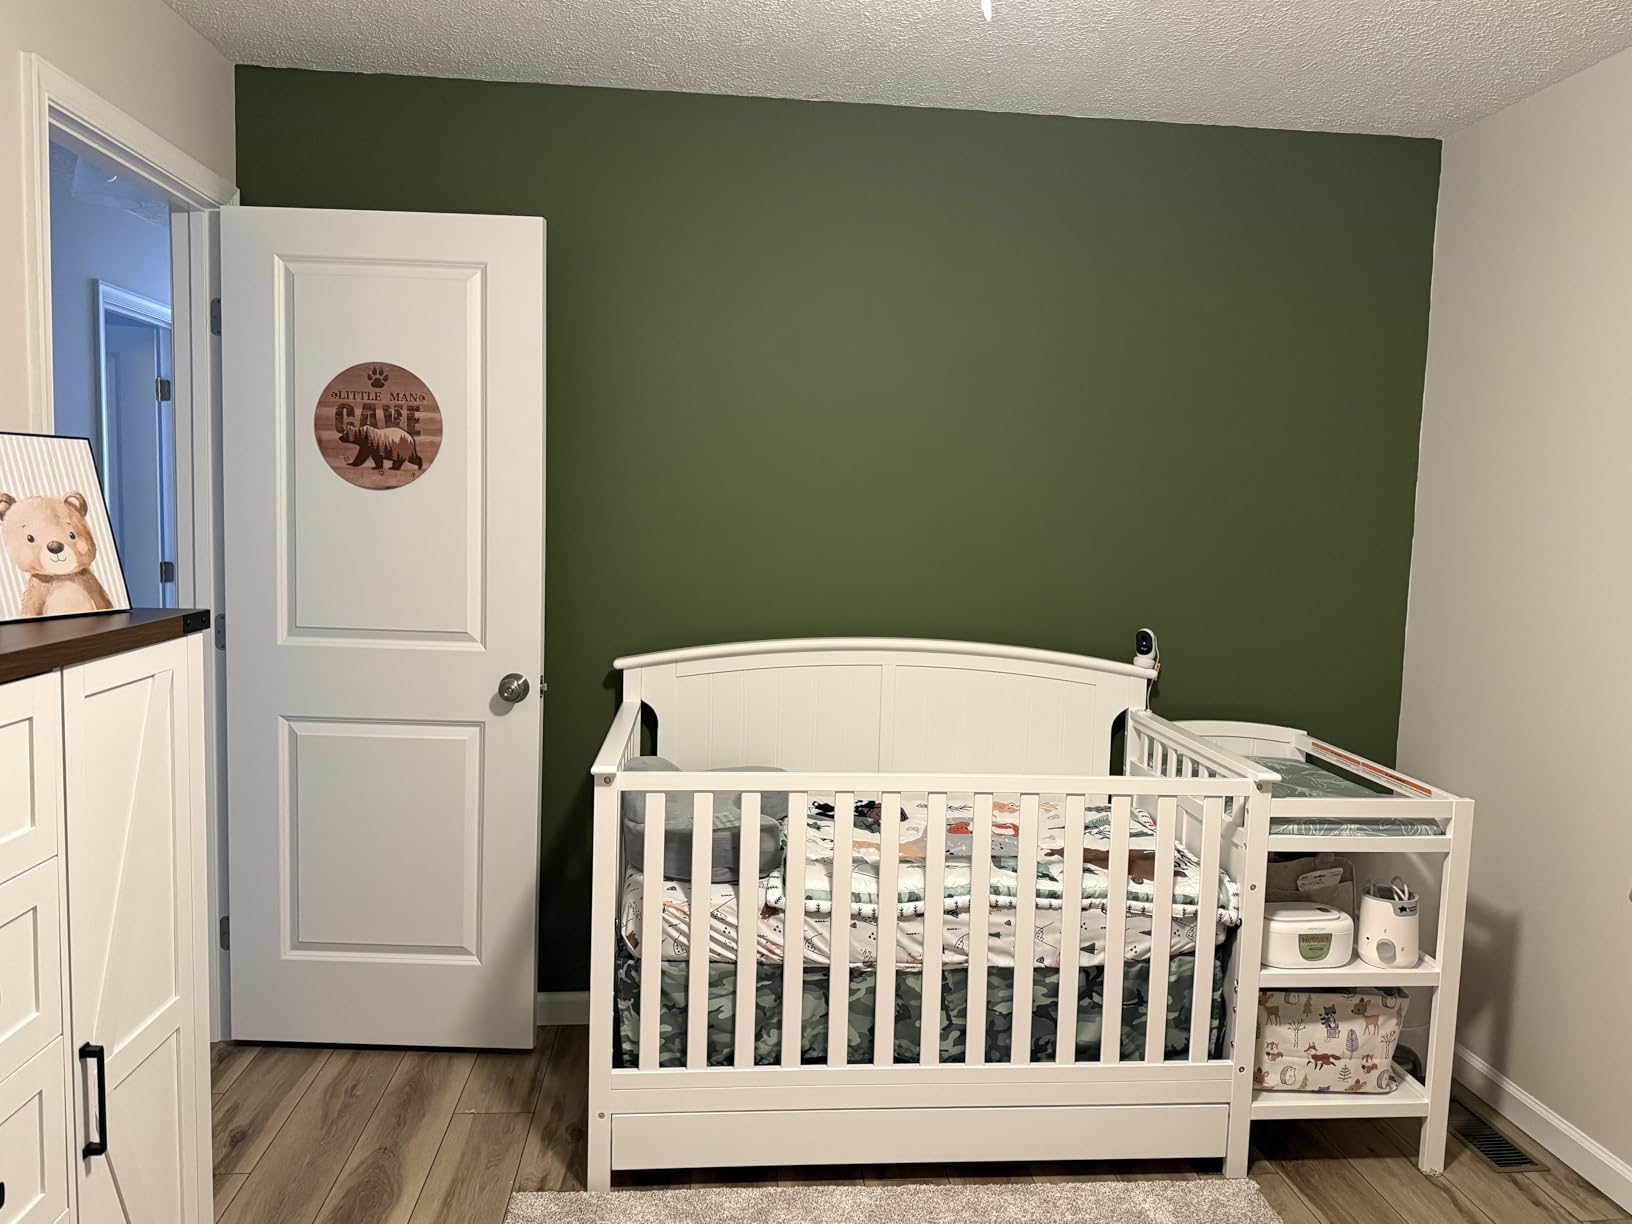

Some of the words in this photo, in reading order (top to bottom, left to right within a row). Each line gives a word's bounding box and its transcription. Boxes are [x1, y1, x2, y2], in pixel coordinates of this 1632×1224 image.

[338, 390, 382, 401] LITTLE
[390, 392, 419, 402] MAN
[335, 402, 422, 437] CAVE
